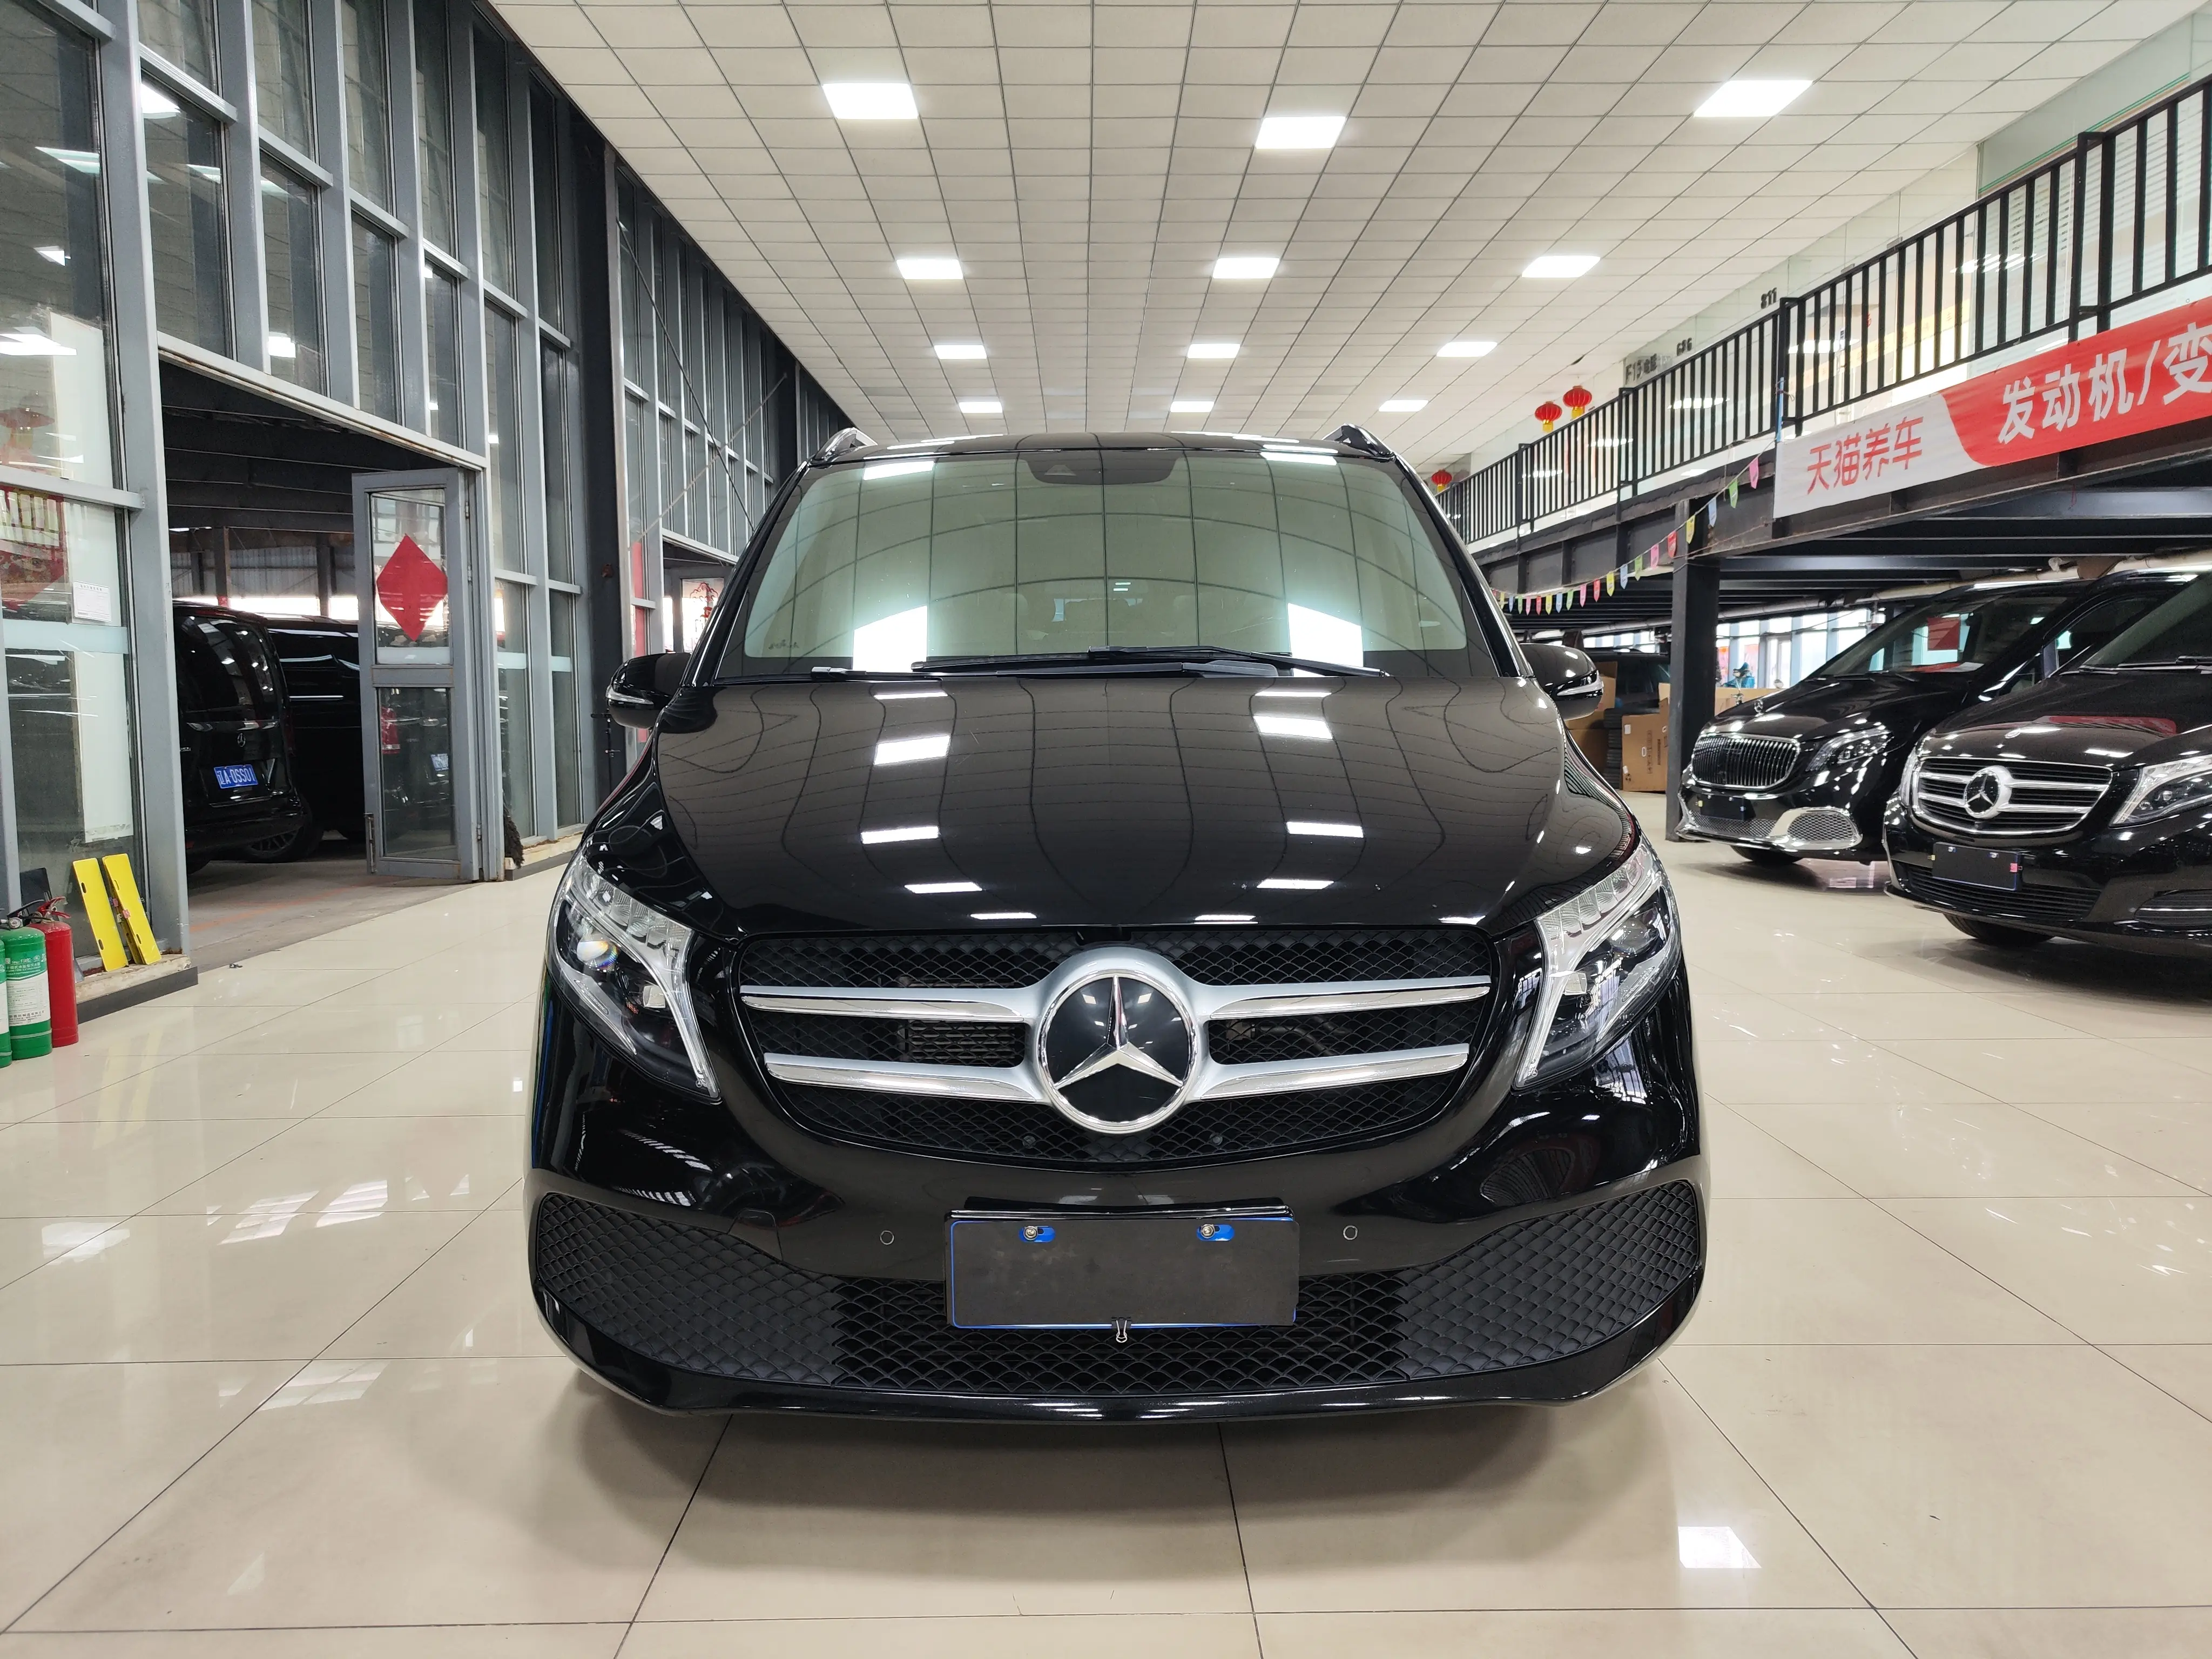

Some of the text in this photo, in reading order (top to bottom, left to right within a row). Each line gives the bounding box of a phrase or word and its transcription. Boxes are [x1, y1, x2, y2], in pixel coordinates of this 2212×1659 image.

[1998, 322, 2212, 444] 发动机/变
[1807, 416, 1924, 495] 天猫养车
